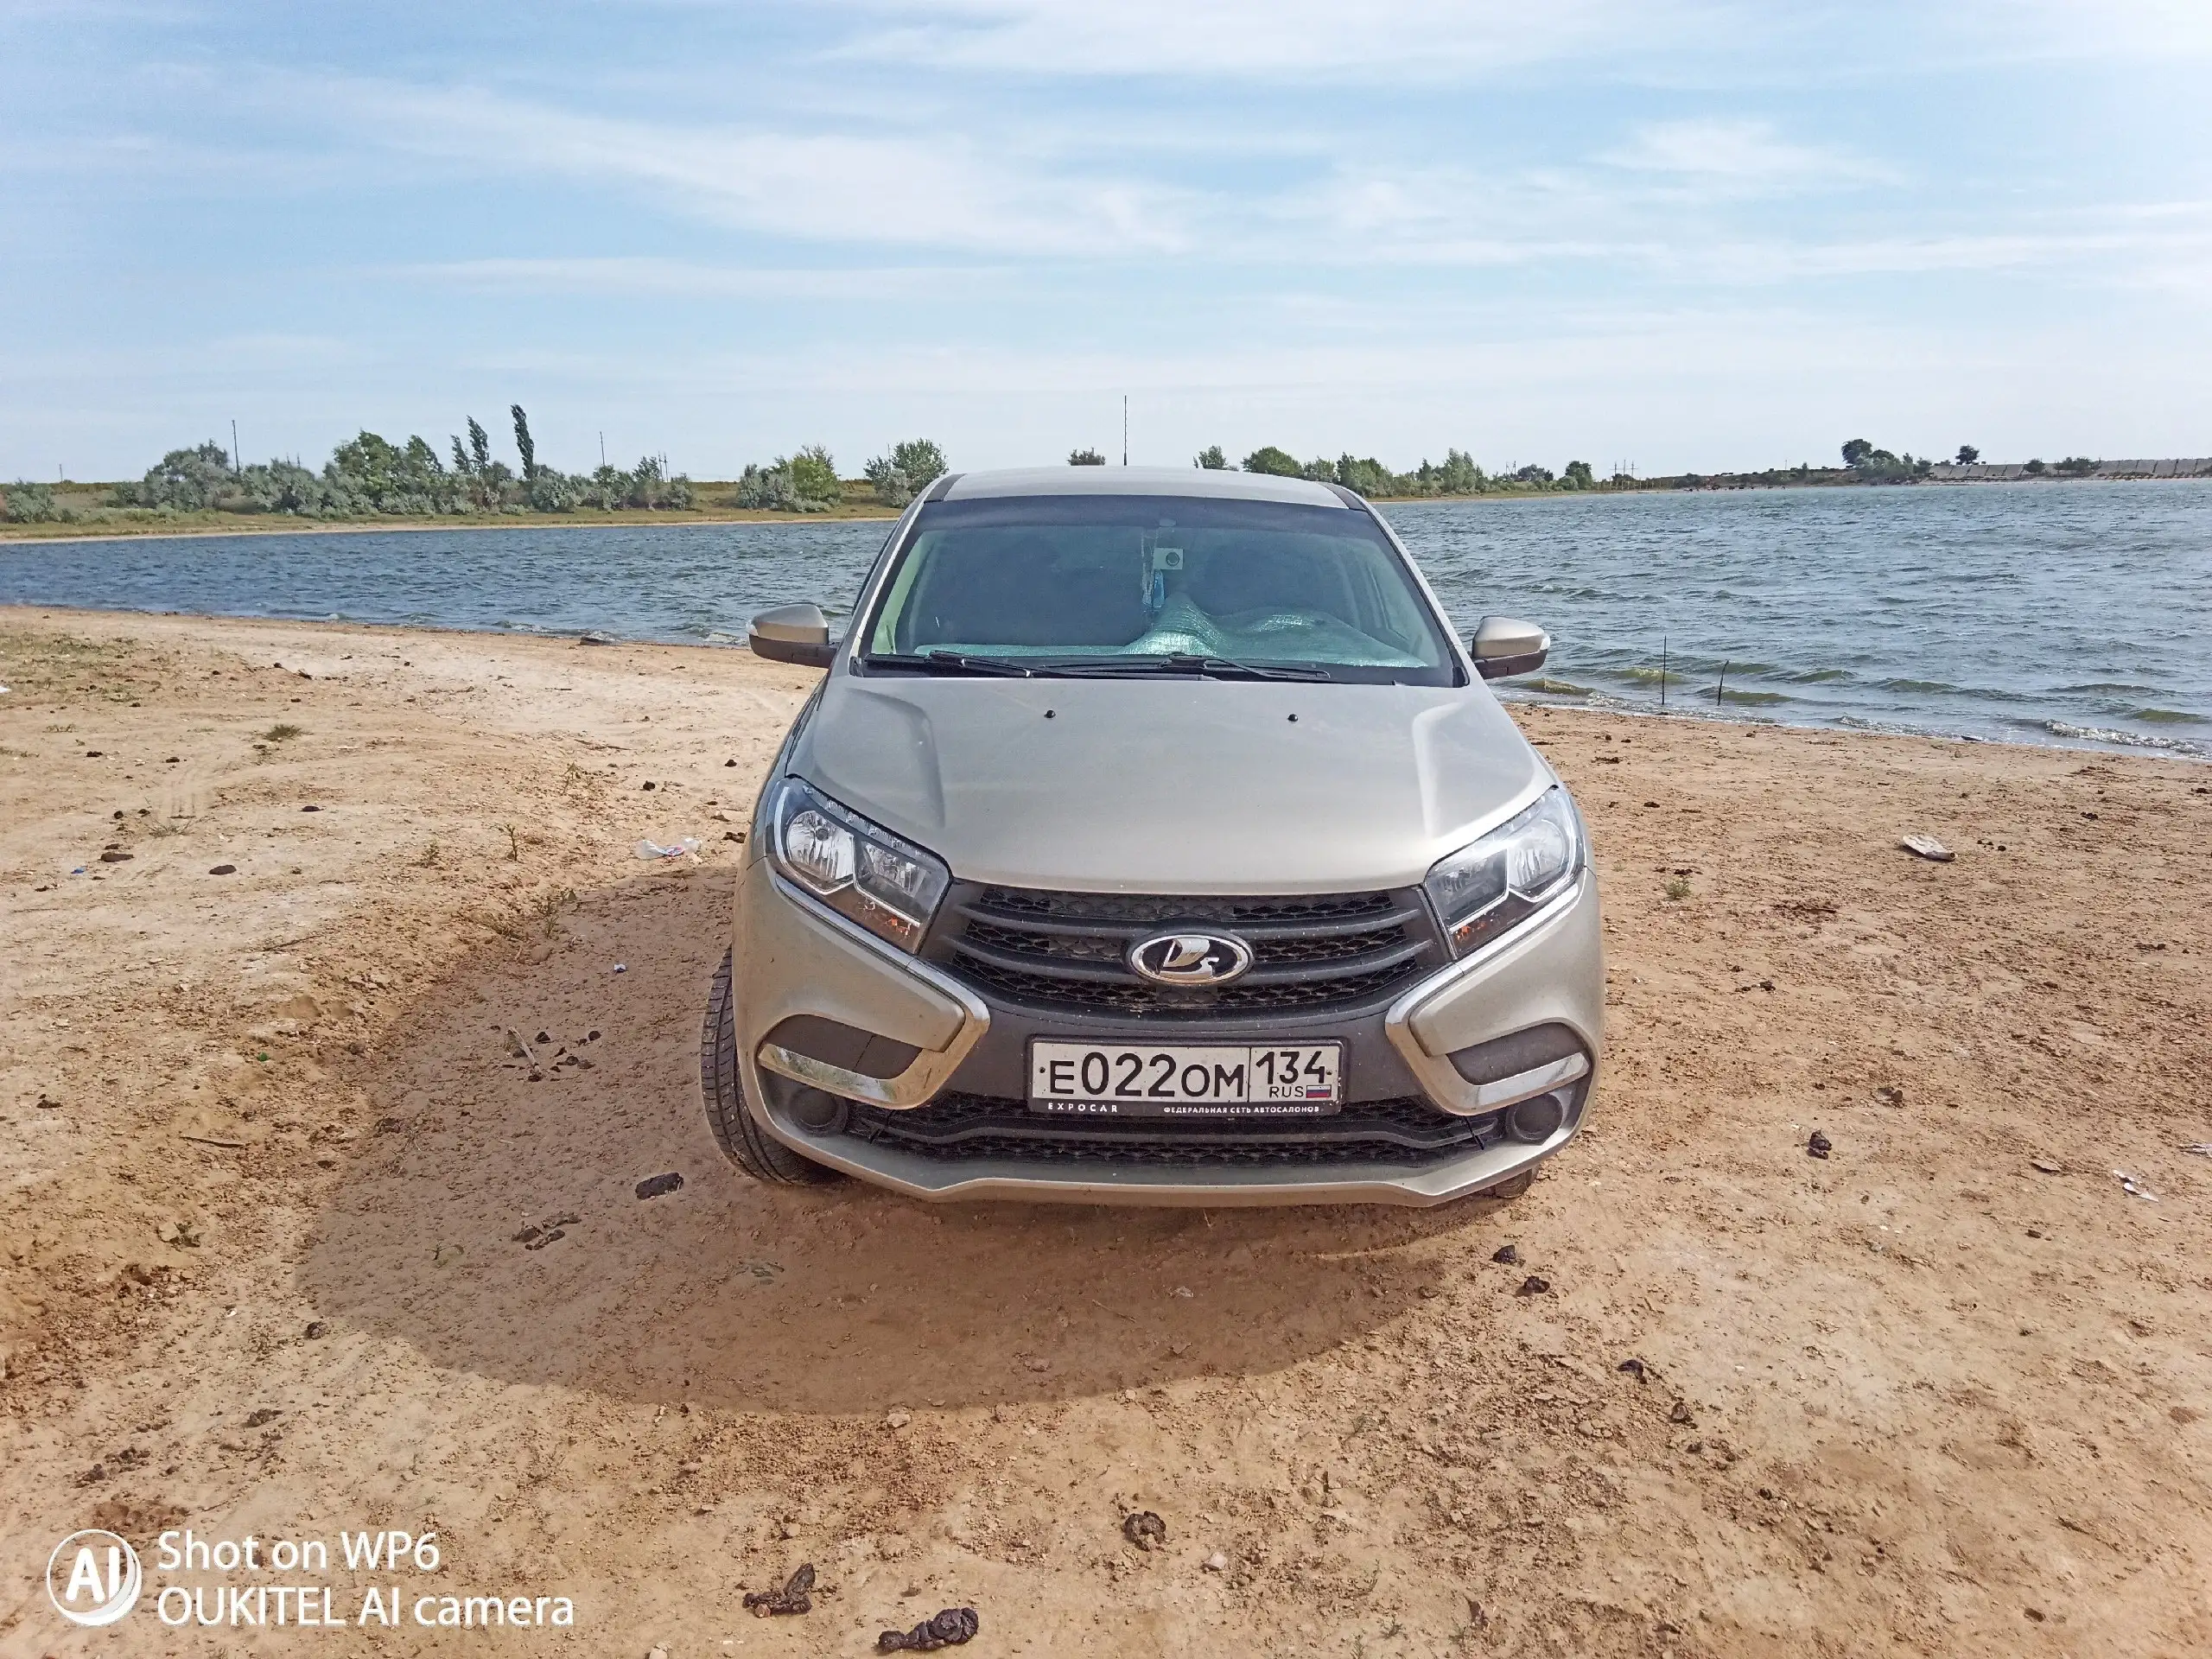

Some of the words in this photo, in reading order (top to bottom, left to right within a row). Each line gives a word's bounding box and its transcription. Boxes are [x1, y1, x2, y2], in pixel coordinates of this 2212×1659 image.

[1255, 1051, 1325, 1085] 134
[1268, 1085, 1304, 1098] RUS
[1047, 1102, 1118, 1113] EXPOCAR
